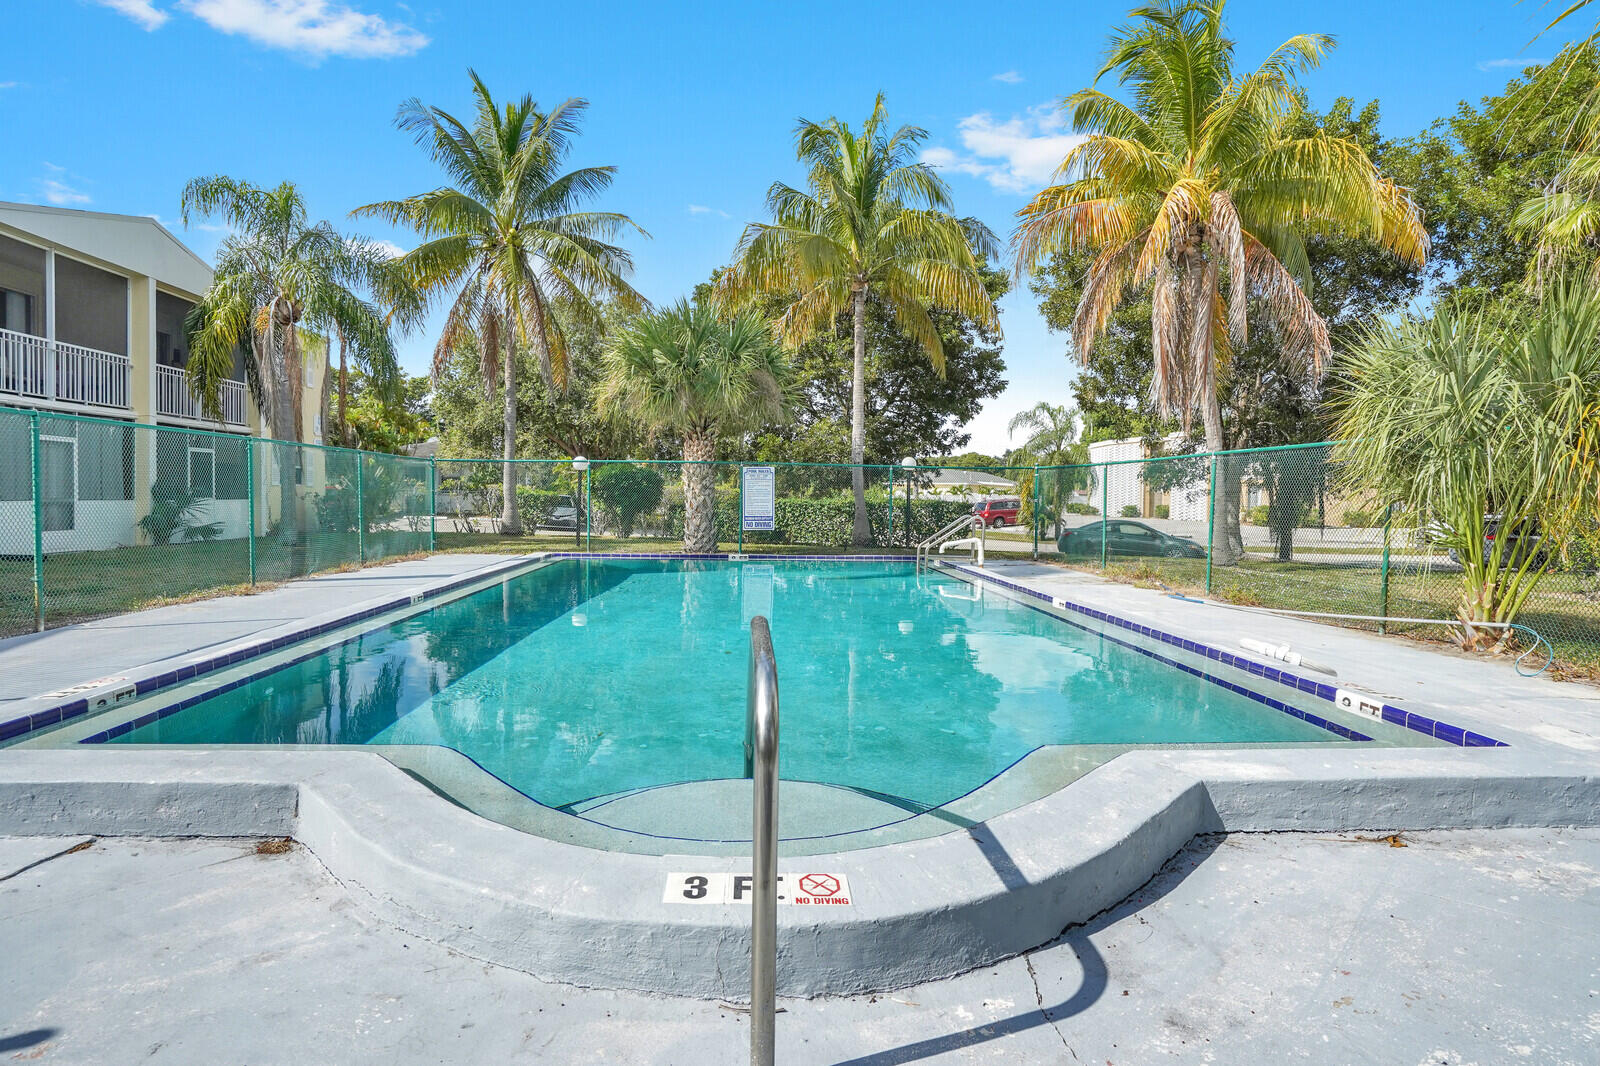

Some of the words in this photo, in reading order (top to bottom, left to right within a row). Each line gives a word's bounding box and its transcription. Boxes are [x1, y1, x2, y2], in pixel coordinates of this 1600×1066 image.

[682, 875, 709, 900] 3
[795, 897, 811, 905] NO
[813, 897, 850, 905] DIVING
